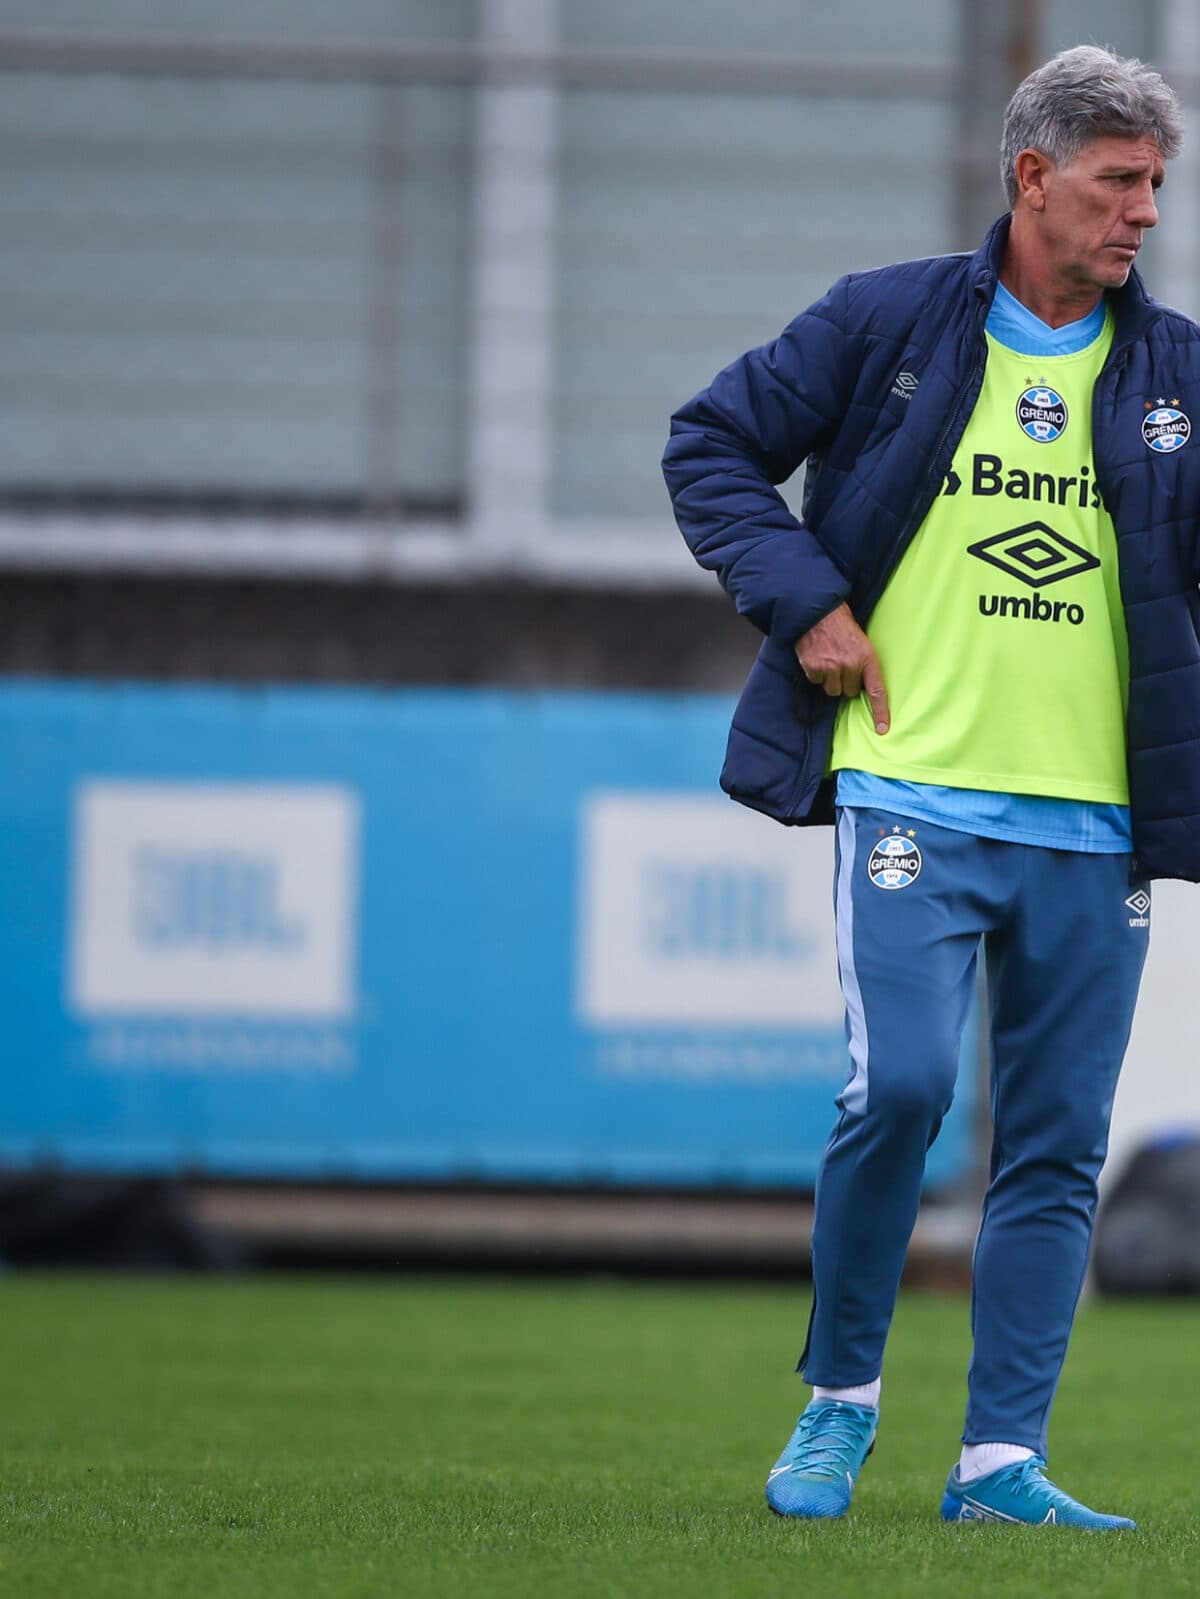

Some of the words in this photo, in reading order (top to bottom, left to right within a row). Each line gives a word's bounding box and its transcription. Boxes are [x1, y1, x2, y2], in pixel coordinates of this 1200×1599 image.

[1020, 406, 1064, 424] GRÊMIO
[1144, 422, 1188, 438] GRÊMIO
[979, 592, 1084, 625] umbro
[871, 854, 918, 870] GRÊMIO
